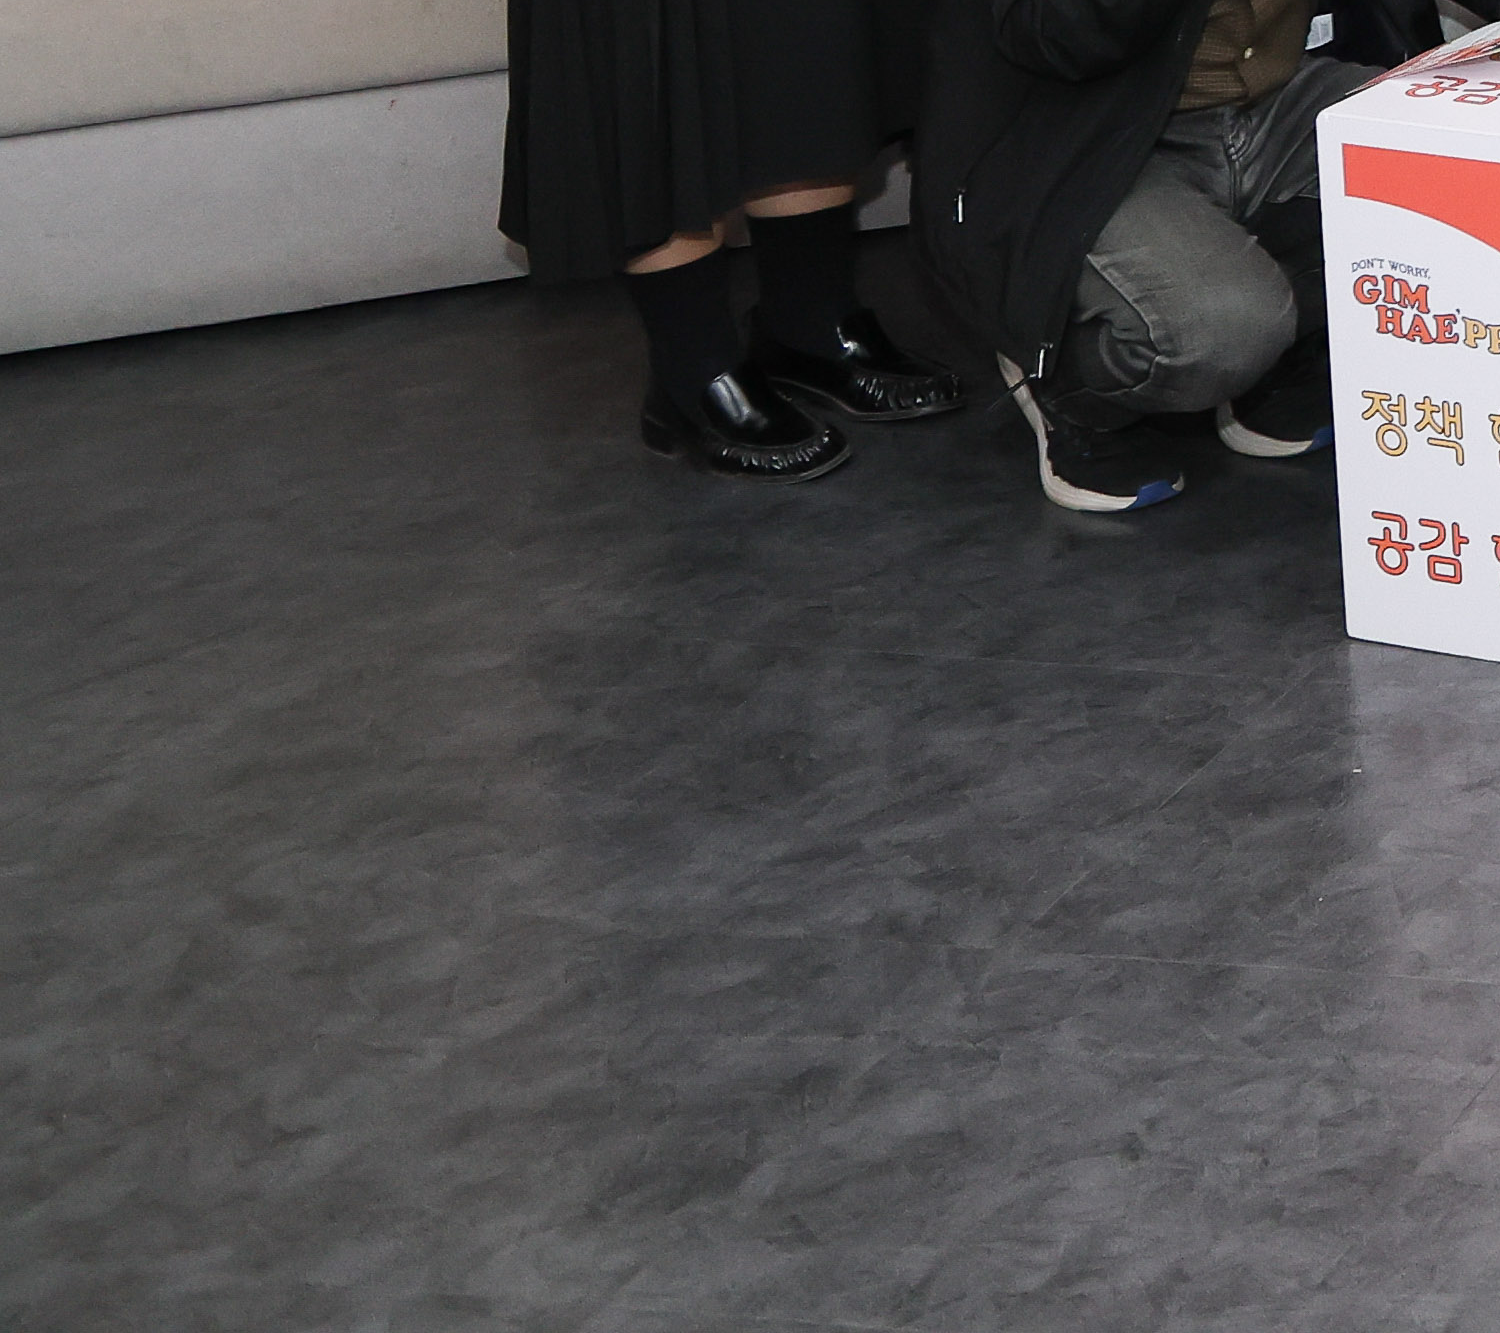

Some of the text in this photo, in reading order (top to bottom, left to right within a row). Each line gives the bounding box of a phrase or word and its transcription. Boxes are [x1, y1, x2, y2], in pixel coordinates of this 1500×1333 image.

[1351, 258, 1385, 273] DON'T
[1353, 274, 1431, 315] GIM
[1361, 390, 1465, 466] 정책
[1367, 510, 1470, 584] 공감
